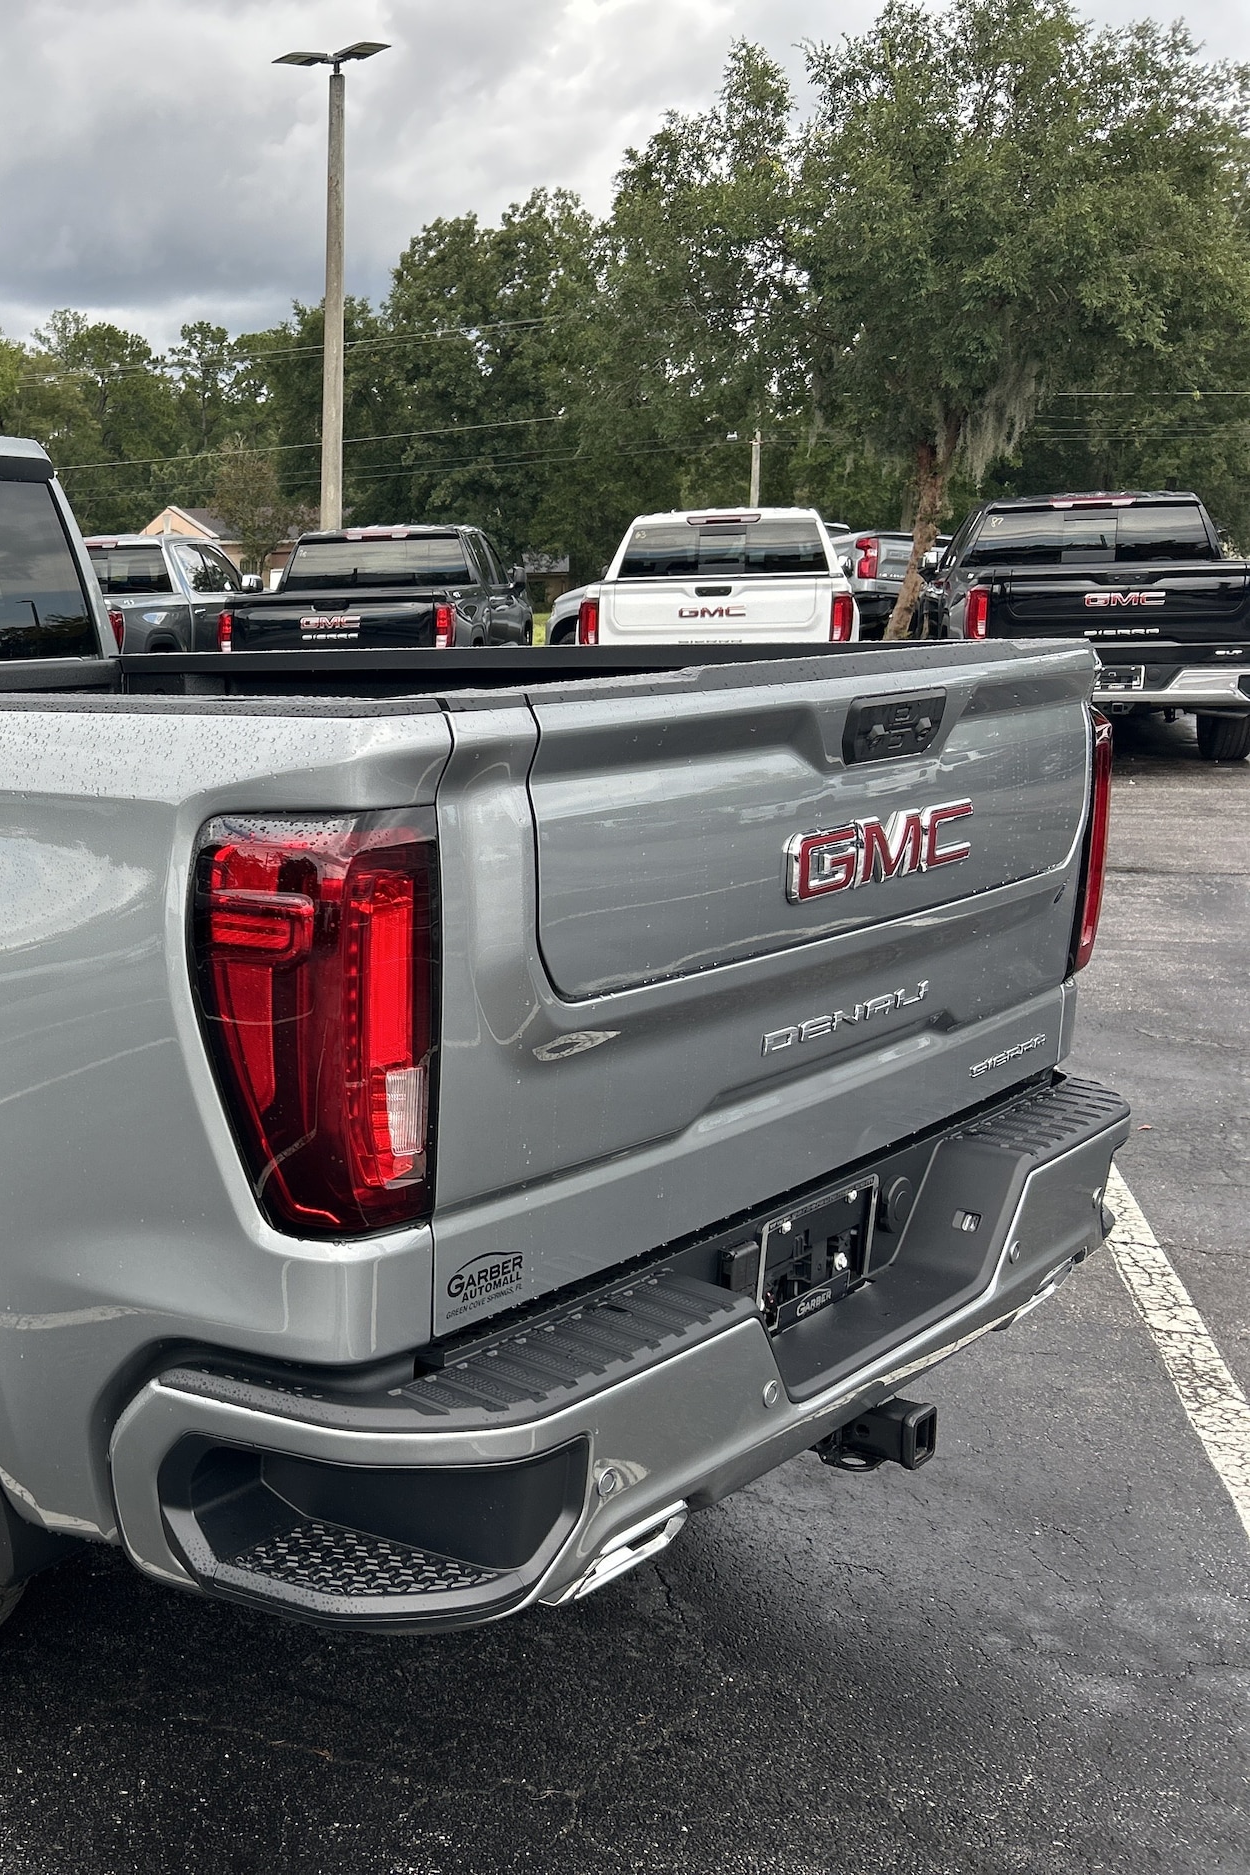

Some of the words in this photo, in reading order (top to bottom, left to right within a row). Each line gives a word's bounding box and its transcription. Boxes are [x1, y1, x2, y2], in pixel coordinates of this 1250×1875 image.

[678, 605, 746, 619] GMC
[1084, 591, 1166, 607] GMC
[300, 615, 361, 630] GMC
[782, 797, 974, 905] GMC
[761, 979, 929, 1057] DENALI
[968, 1032, 1046, 1078] SIERRA
[447, 1254, 523, 1298] GARBER
[462, 1271, 522, 1303] AUTOMALL
[446, 1305, 468, 1319] GREEN
[469, 1297, 486, 1310] COVE
[515, 1283, 523, 1291] FL
[796, 1292, 832, 1317] GARBER
